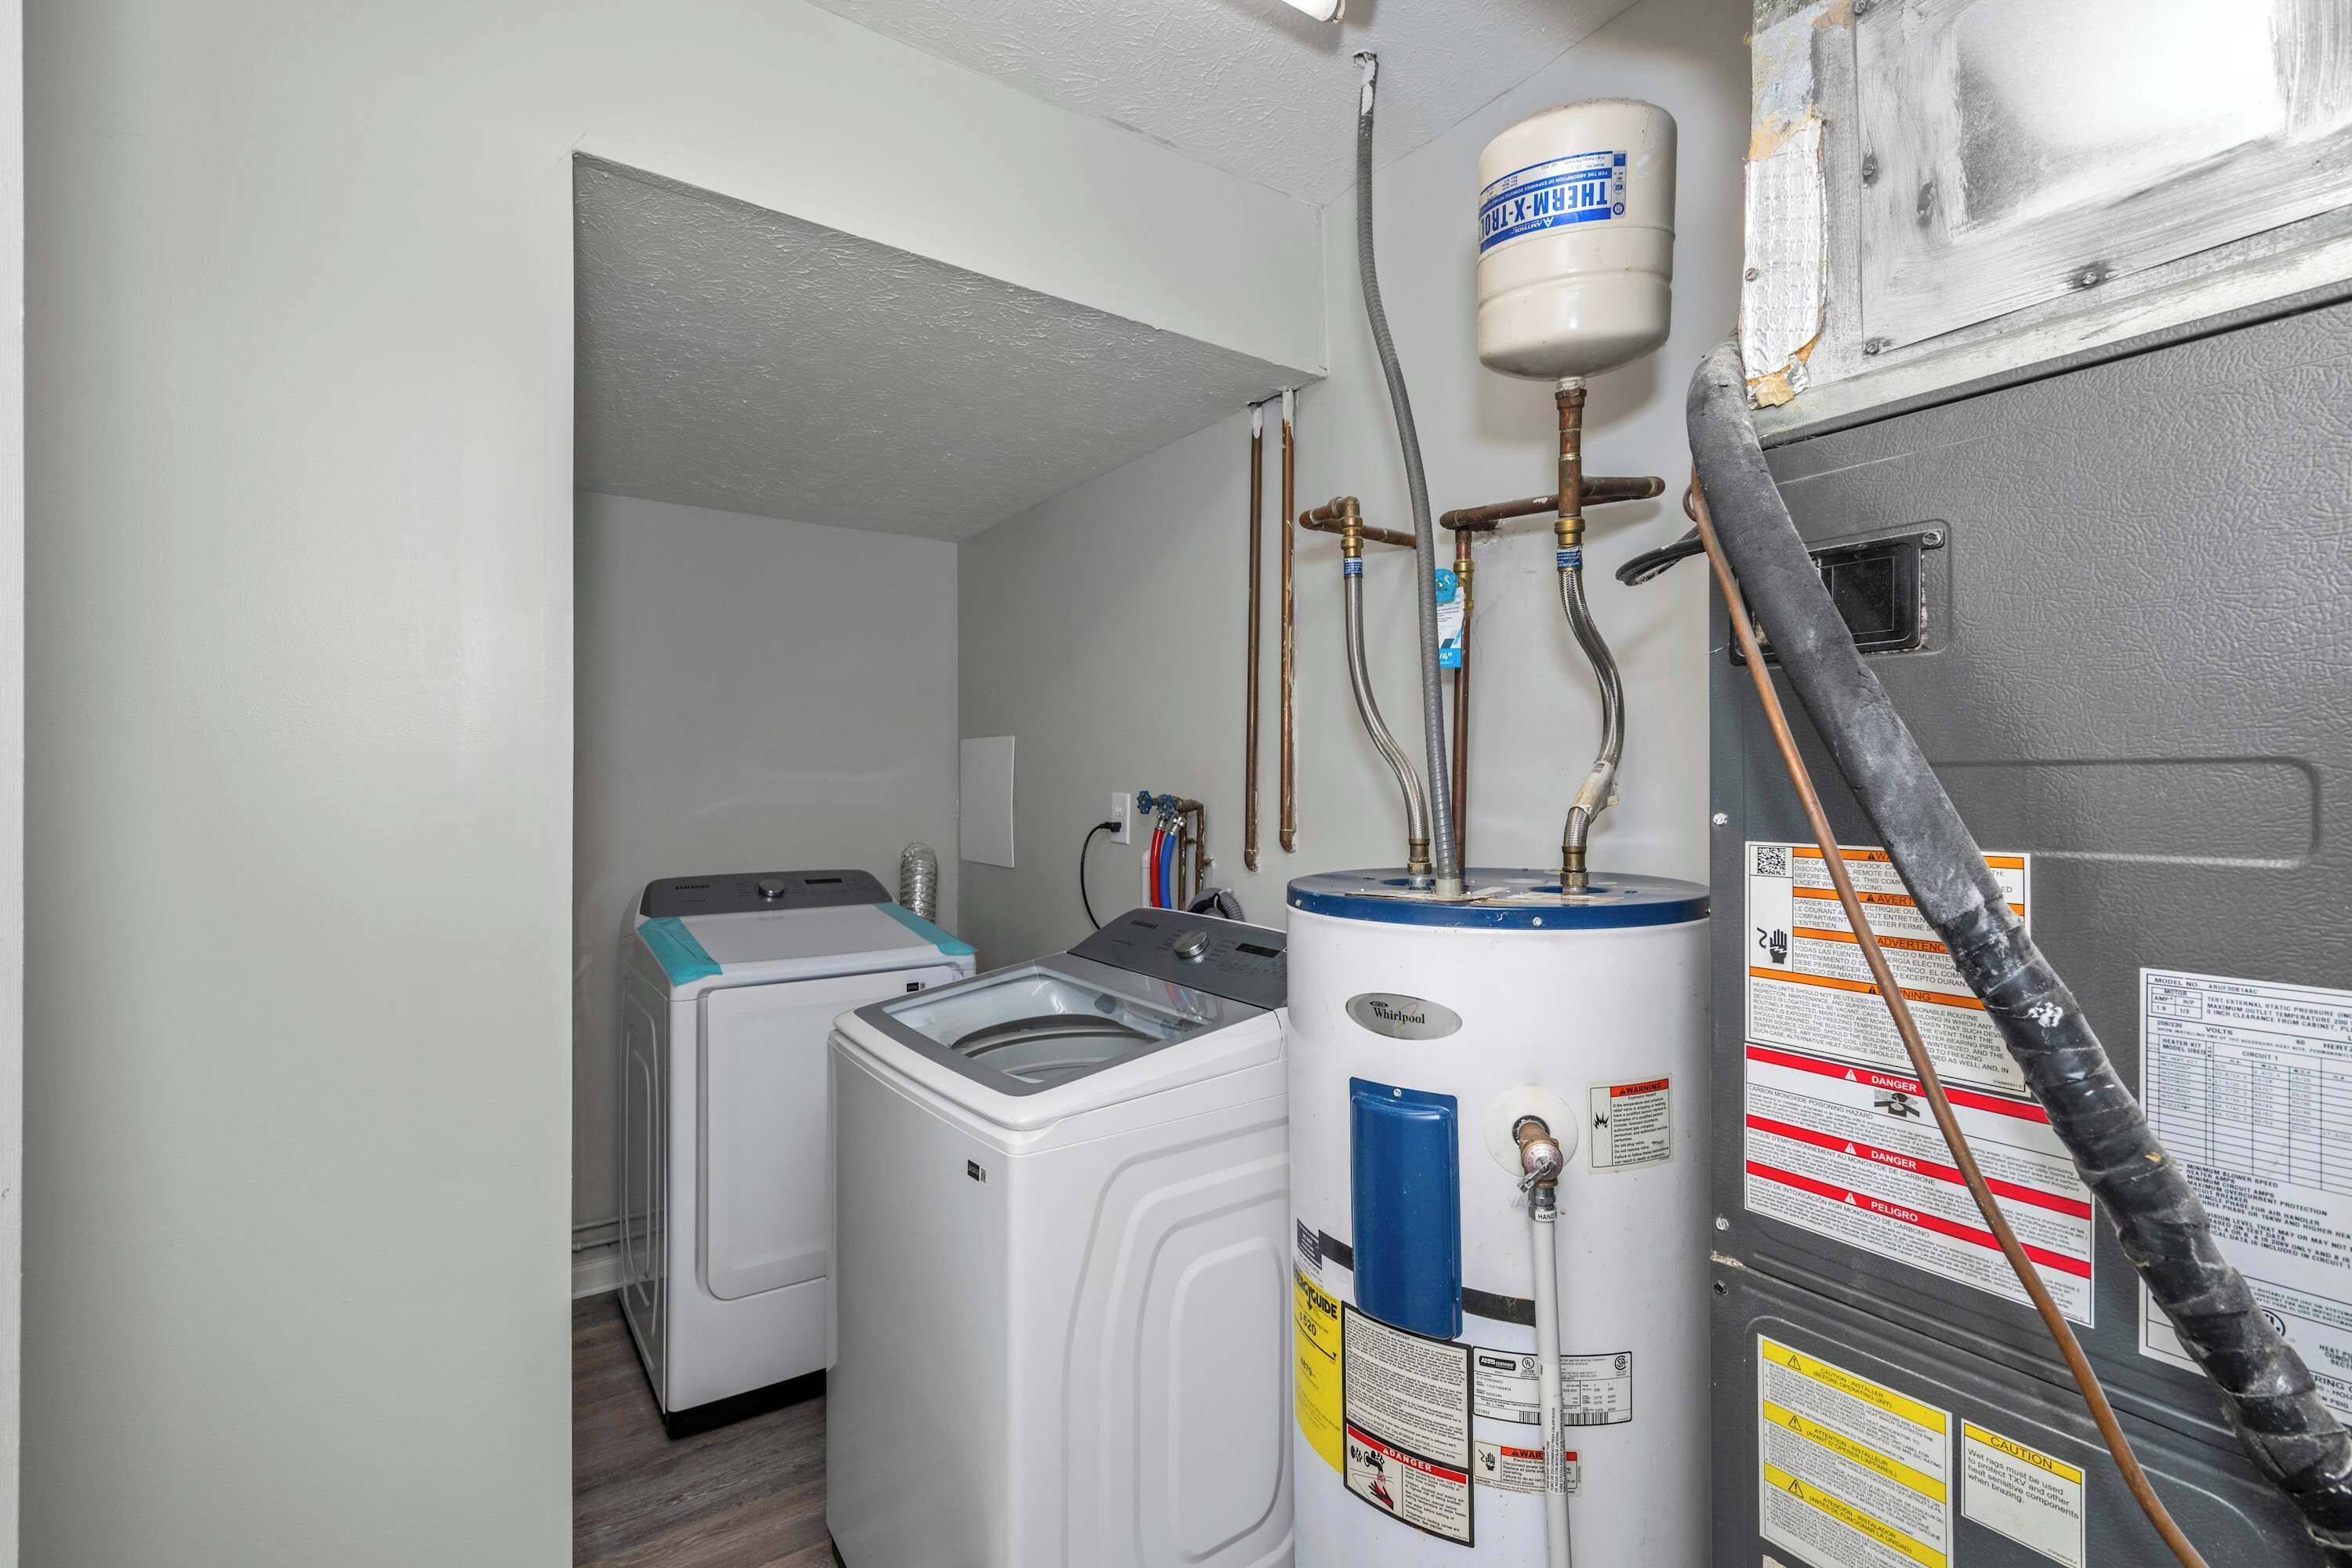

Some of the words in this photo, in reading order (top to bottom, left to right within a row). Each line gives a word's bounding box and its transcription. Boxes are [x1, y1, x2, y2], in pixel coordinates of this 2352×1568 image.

[1481, 182, 1607, 239] THERM-X-TROL
[1794, 913, 1847, 922] COMPARTIMENT
[1877, 937, 1946, 952] ADVERTENC
[1795, 953, 1849, 964] MANTENIMIENTO
[1832, 949, 1864, 959] FUENTES
[1795, 966, 1825, 975] SERVICIO
[1813, 962, 1860, 973] PERMANECER
[1900, 973, 1936, 983] EXCEPTO
[1784, 998, 1810, 1007] LOCATED
[1795, 988, 1818, 996] SHOULD
[1842, 995, 1869, 1004] UTILIZED
[1903, 989, 1930, 1001] NING
[1753, 999, 1784, 1008] ROUTINELY
[2226, 998, 2262, 1007] EXTERNAL
[2294, 1007, 2333, 1017] PRESSURE
[1374, 1007, 1425, 1024] Whirlpool
[1823, 1016, 1852, 1025] FREEZING
[1947, 1011, 1978, 1021] ROUTINE
[2207, 1004, 2243, 1012] MAXIMUM
[2276, 1011, 2330, 1023] TEMPERATURE
[2233, 1012, 2274, 1022] CLEARANCE
[1951, 1019, 1976, 1028] WHICH
[1787, 1033, 1824, 1045] ALTERNATIVE
[1824, 1029, 1848, 1037] SHOULD
[1853, 1028, 1878, 1036] SHOULD
[1934, 1029, 1958, 1037] EVENT
[1962, 1027, 1982, 1036] SUCH
[1879, 1044, 1905, 1054] SHOULD
[1980, 1044, 2001, 1052] PIPES
[2162, 1038, 2188, 1047] HEATER
[1947, 1051, 1982, 1062] FREEZING
[2241, 1051, 2271, 1060] CIRCUIT
[1626, 1083, 1661, 1094] WARNING
[1871, 1075, 1917, 1092] DANGER
[1748, 1085, 1774, 1098] CARBON
[1774, 1091, 1807, 1104] MONOXIDE
[1808, 1099, 1845, 1113] POISONING
[1846, 1109, 1874, 1120] HAZARD
[1748, 1129, 1771, 1140] RISQUE
[1848, 1156, 1887, 1171] MONOXYDE
[1889, 1166, 1898, 1174] DE
[1900, 1169, 1936, 1186] CARBONE
[1871, 1150, 1917, 1170] DANGER
[2187, 1163, 2220, 1175] MINIMUM
[2223, 1171, 2252, 1183] BLOWER
[2254, 1178, 2279, 1189] SPEED
[2187, 1174, 2220, 1186] MINIMUM
[2222, 1181, 2251, 1193] CIRCUIT
[2253, 1189, 2275, 1199] AMPS
[2187, 1180, 2223, 1192] MAXIMUM
[2225, 1187, 2277, 1205] OVERCURRENT
[2280, 1200, 2328, 1216] PROTECTION
[2216, 1192, 2249, 1203] BREAKER
[1749, 1177, 1773, 1189] RIESGO
[1783, 1185, 1827, 1206] INTOXICACIÓN
[1828, 1200, 1843, 1210] POR
[1843, 1206, 1881, 1222] MONÓXIDO
[1882, 1218, 1892, 1226] DE
[1893, 1221, 1930, 1239] CARBONO
[1871, 1201, 1918, 1222] PELIGRO
[2225, 1200, 2248, 1210] PHASE
[2251, 1205, 2266, 1214] FOR
[2284, 1213, 2320, 1226] HANDLER
[2303, 1224, 2332, 1236] HIGHER
[2261, 1242, 2299, 1257] INCLUDED
[2312, 1256, 2343, 1269] CIRCUIT
[1820, 1368, 1847, 1383] CAUTION
[1851, 1380, 1883, 1398] INSTALLER
[1839, 1381, 1875, 1400] OPERATING
[1814, 1428, 1847, 1446] ATTENTION
[1991, 1436, 2053, 1469] CAUTION
[1389, 1450, 1432, 1472] DANGER
[1968, 1449, 1984, 1461] Wet
[1986, 1457, 2004, 1469] rags
[2006, 1466, 2027, 1479] must
[2029, 1475, 2040, 1485] be
[2042, 1483, 2063, 1495] used
[1968, 1473, 1990, 1487] when
[1991, 1483, 2024, 1504] brazing.
[1978, 1461, 2005, 1478] protect
[2008, 1475, 2026, 1486] TXV
[2028, 1484, 2045, 1496] and
[2047, 1492, 2070, 1506] other
[1968, 1465, 1987, 1477] heat
[1988, 1473, 2024, 1494] sensitive
[2026, 1491, 2079, 1519] components
[1830, 1505, 1839, 1515] DE
[1877, 1530, 1883, 1538] LA
[1857, 1515, 1896, 1538] INSTALADOR
